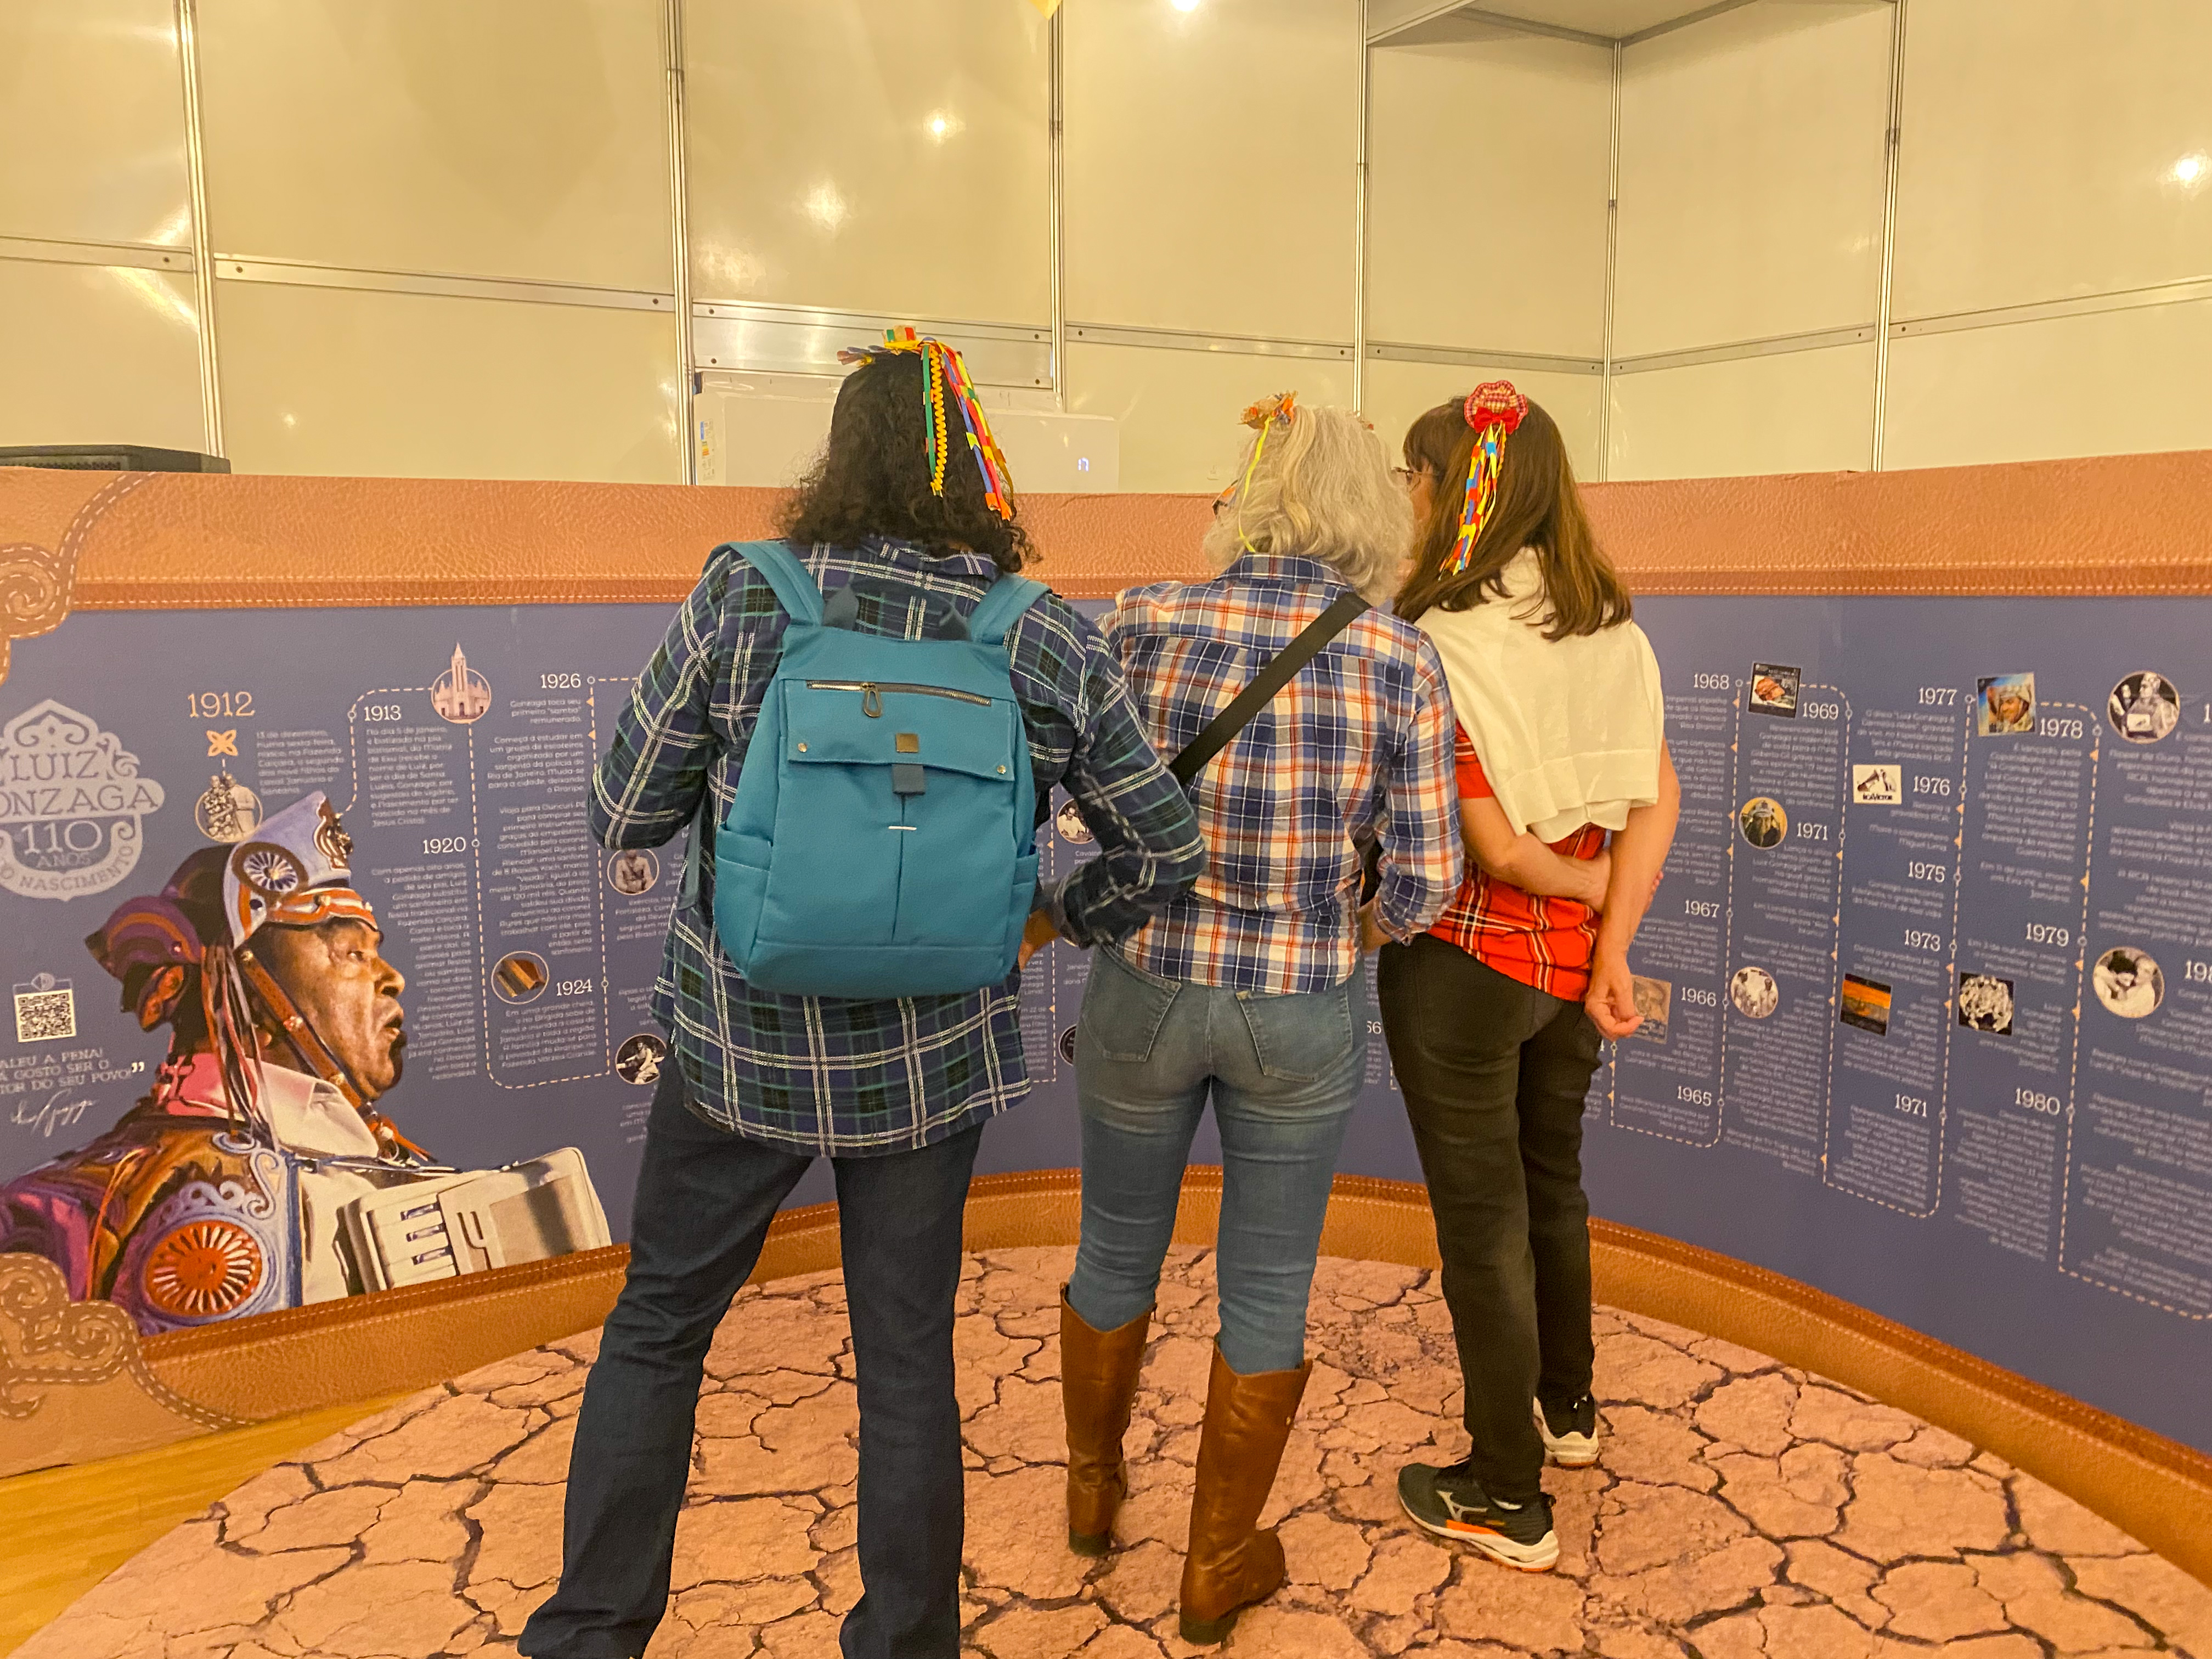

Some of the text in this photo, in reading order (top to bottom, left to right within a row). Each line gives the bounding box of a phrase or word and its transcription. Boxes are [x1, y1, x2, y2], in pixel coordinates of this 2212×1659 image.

[540, 673, 582, 689] 1926
[1694, 673, 1729, 690] 1968
[188, 691, 256, 718] 1912
[1918, 687, 1957, 706] 1977
[364, 704, 402, 721] 1913
[1803, 702, 1839, 720] 1969
[2040, 718, 2083, 739] 1978
[10, 750, 99, 781] LUIZ
[1913, 776, 1951, 796] 1976
[21, 820, 103, 854] 110
[1797, 822, 1828, 841] 1971
[422, 836, 466, 854] 1920
[19, 846, 133, 891] NASCIMENTO
[1908, 861, 1946, 883] 1975
[1685, 900, 1720, 918] 1967
[1904, 929, 1940, 952] 1973
[2026, 923, 2069, 947] 1979
[2185, 960, 2212, 983] 19
[556, 979, 592, 996] 1924
[1681, 987, 1717, 1007] 1966
[1677, 1086, 1712, 1107] 1965
[1895, 1094, 1927, 1118] 1971
[2015, 1088, 2061, 1115] 1980
